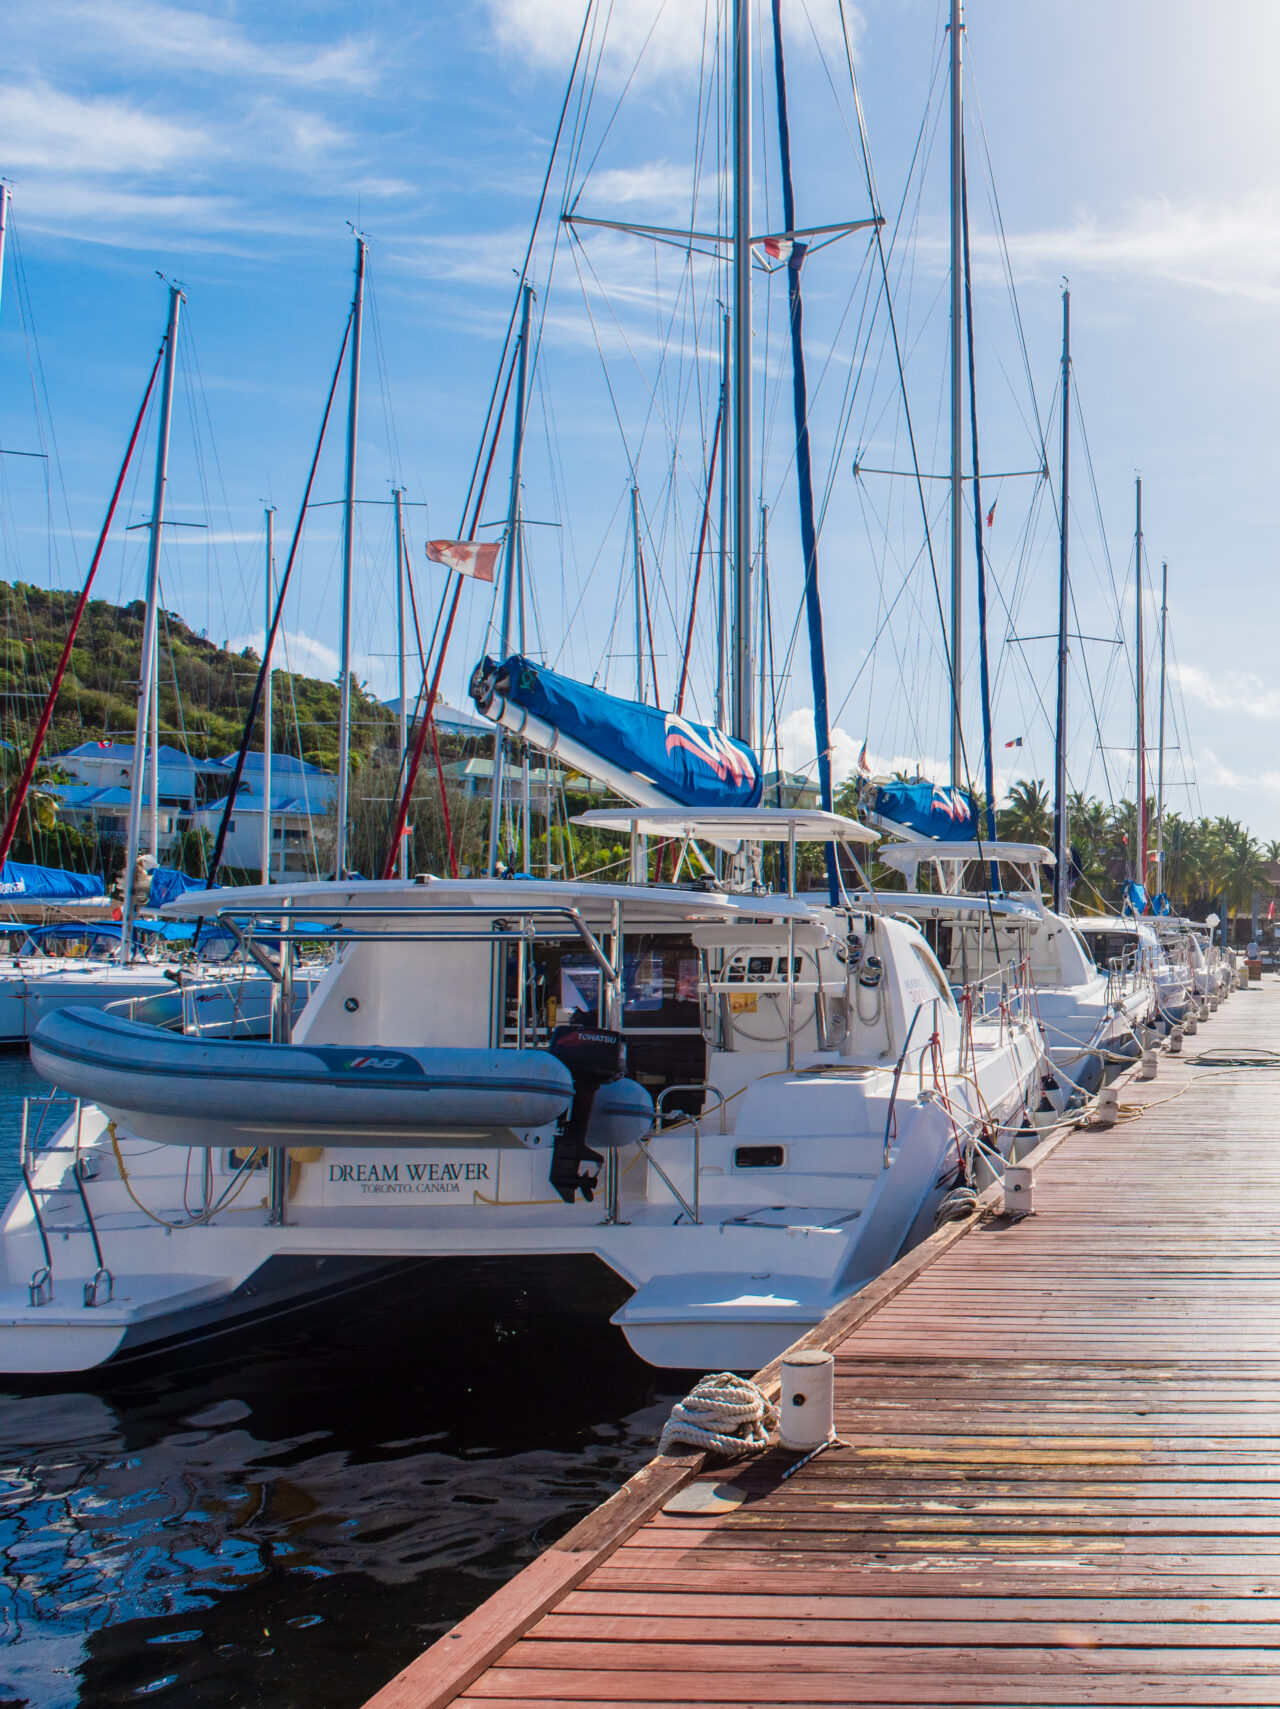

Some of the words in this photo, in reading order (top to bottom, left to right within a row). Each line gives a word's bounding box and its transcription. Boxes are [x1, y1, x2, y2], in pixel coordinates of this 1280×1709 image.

[577, 1033, 617, 1044] TOHATSU
[328, 1164, 400, 1182] DREAM
[405, 1162, 490, 1181] WEAVER
[416, 1182, 461, 1193] CANADA
